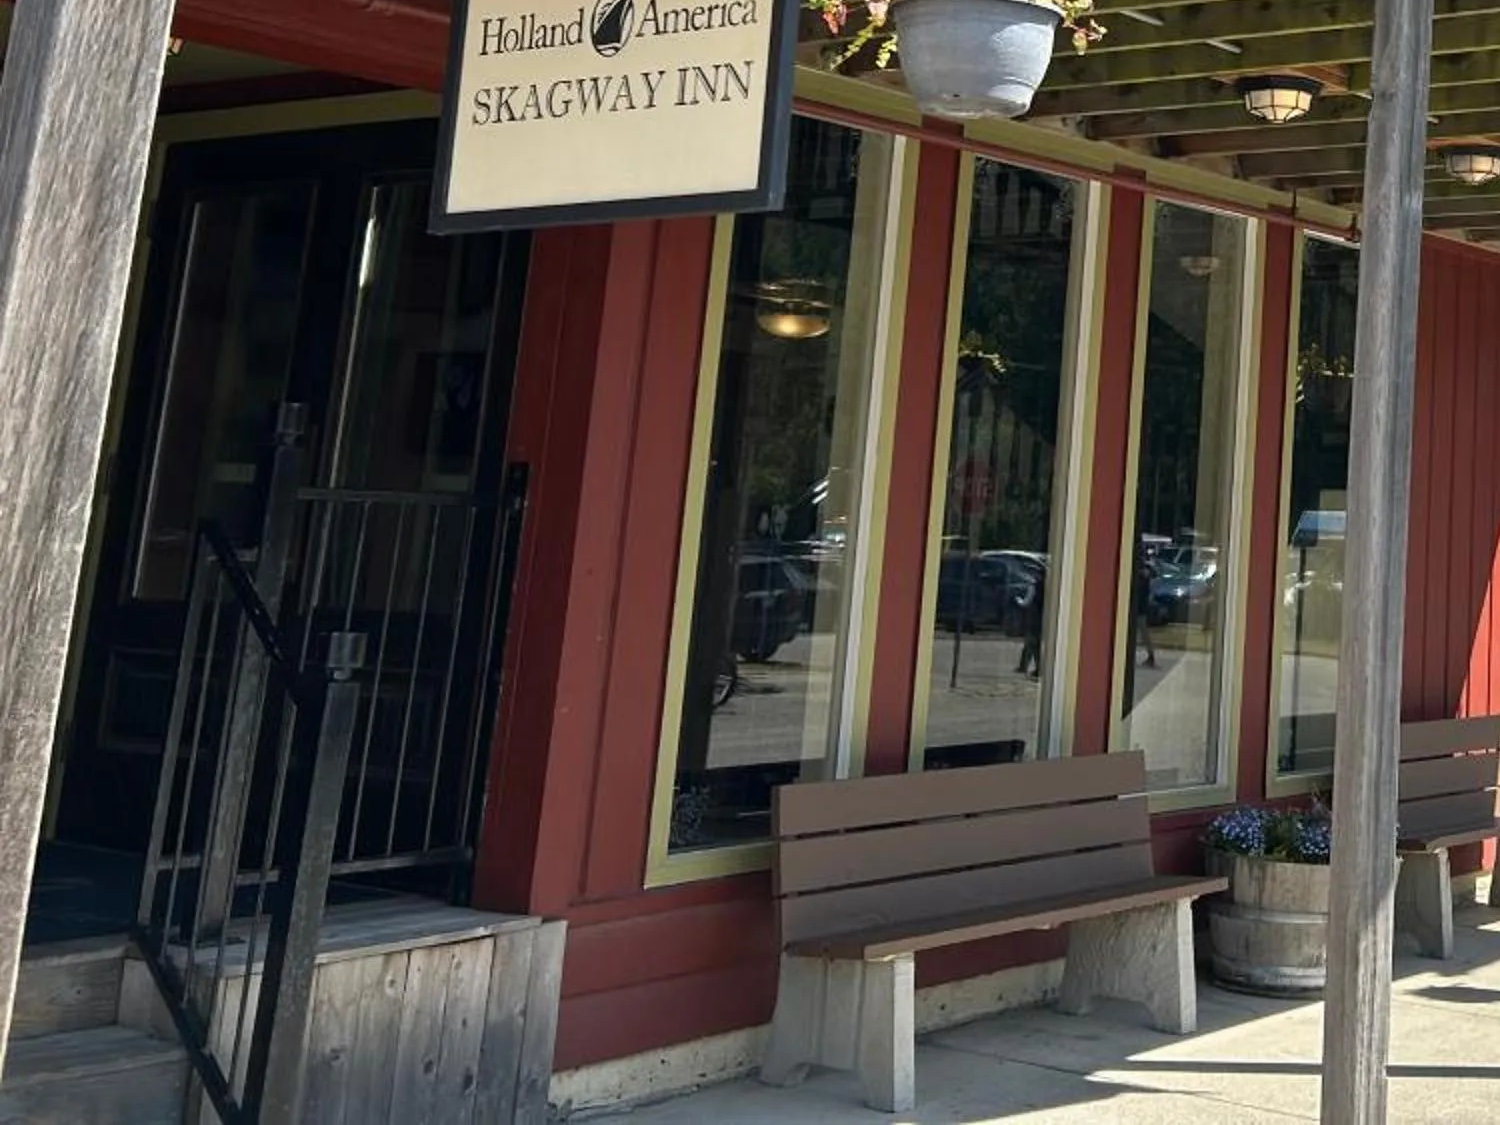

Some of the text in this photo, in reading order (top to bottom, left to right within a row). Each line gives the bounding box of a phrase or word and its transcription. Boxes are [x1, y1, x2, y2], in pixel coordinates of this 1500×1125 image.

[479, 7, 584, 56] Holland
[471, 60, 755, 126] SKAGWAY INN
